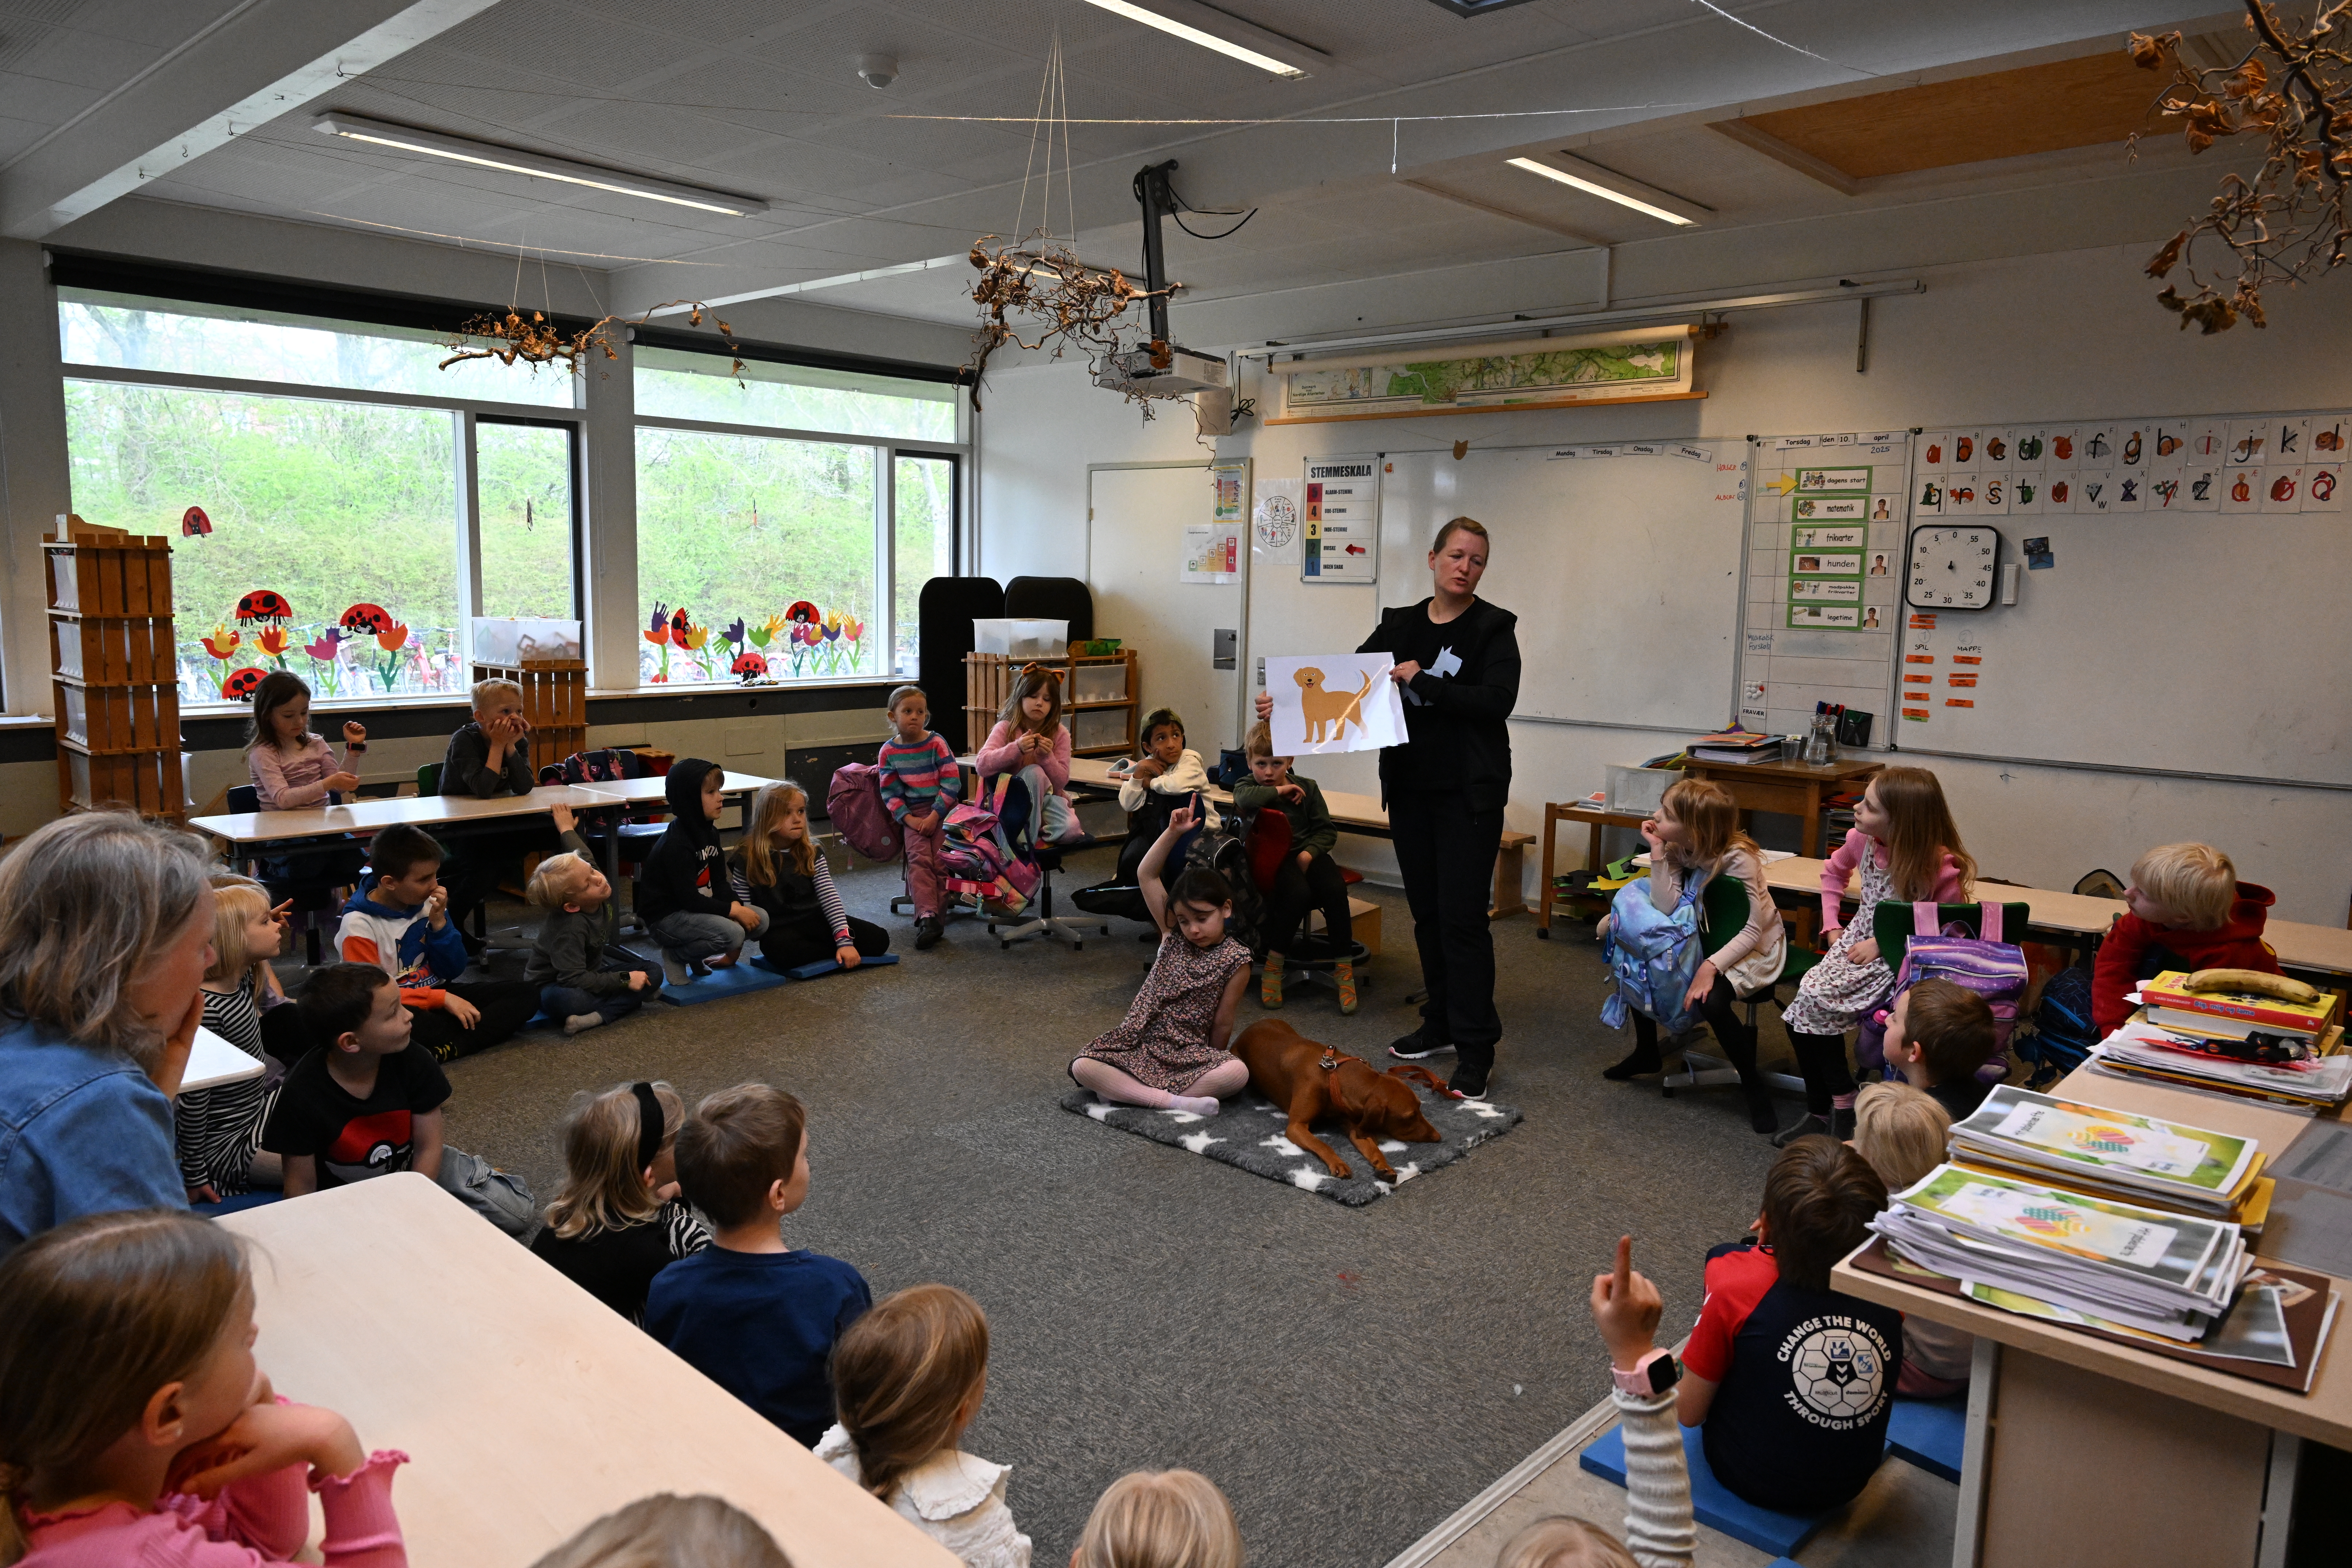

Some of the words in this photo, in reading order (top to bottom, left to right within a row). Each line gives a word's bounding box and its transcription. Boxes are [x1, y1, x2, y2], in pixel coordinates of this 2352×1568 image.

[2018, 435, 2035, 460] d
[2090, 433, 2105, 459] f
[2156, 428, 2174, 456] h
[2205, 430, 2212, 455] i
[2234, 429, 2254, 463] j
[2281, 425, 2298, 453] k
[1681, 448, 1701, 458] Fredag
[1956, 437, 1971, 462] b
[1993, 443, 2006, 460] c
[2124, 438, 2142, 465] g
[1311, 465, 1372, 479] STEMMESKALA
[2336, 464, 2342, 474] Å
[1312, 487, 1318, 498] 5
[1958, 487, 1973, 505] r
[2015, 479, 2031, 504] t
[2052, 485, 2069, 503] u
[1311, 505, 1317, 517] 4
[1826, 504, 1854, 513] matematik
[1310, 524, 1317, 536] 3
[1826, 533, 1854, 542] frikvarter
[1310, 542, 1316, 554] 2
[1310, 561, 1315, 572] 1
[2194, 1000, 2208, 1009] Dig,
[2210, 1004, 2224, 1012] mig
[2237, 1007, 2255, 1016] lama
[1777, 1317, 1822, 1362] CHANGE
[1822, 1315, 1852, 1328] THE
[1855, 1319, 1892, 1362] WORLD
[1783, 1390, 1854, 1430] THROUGH
[1856, 1390, 1888, 1427] SPORT
